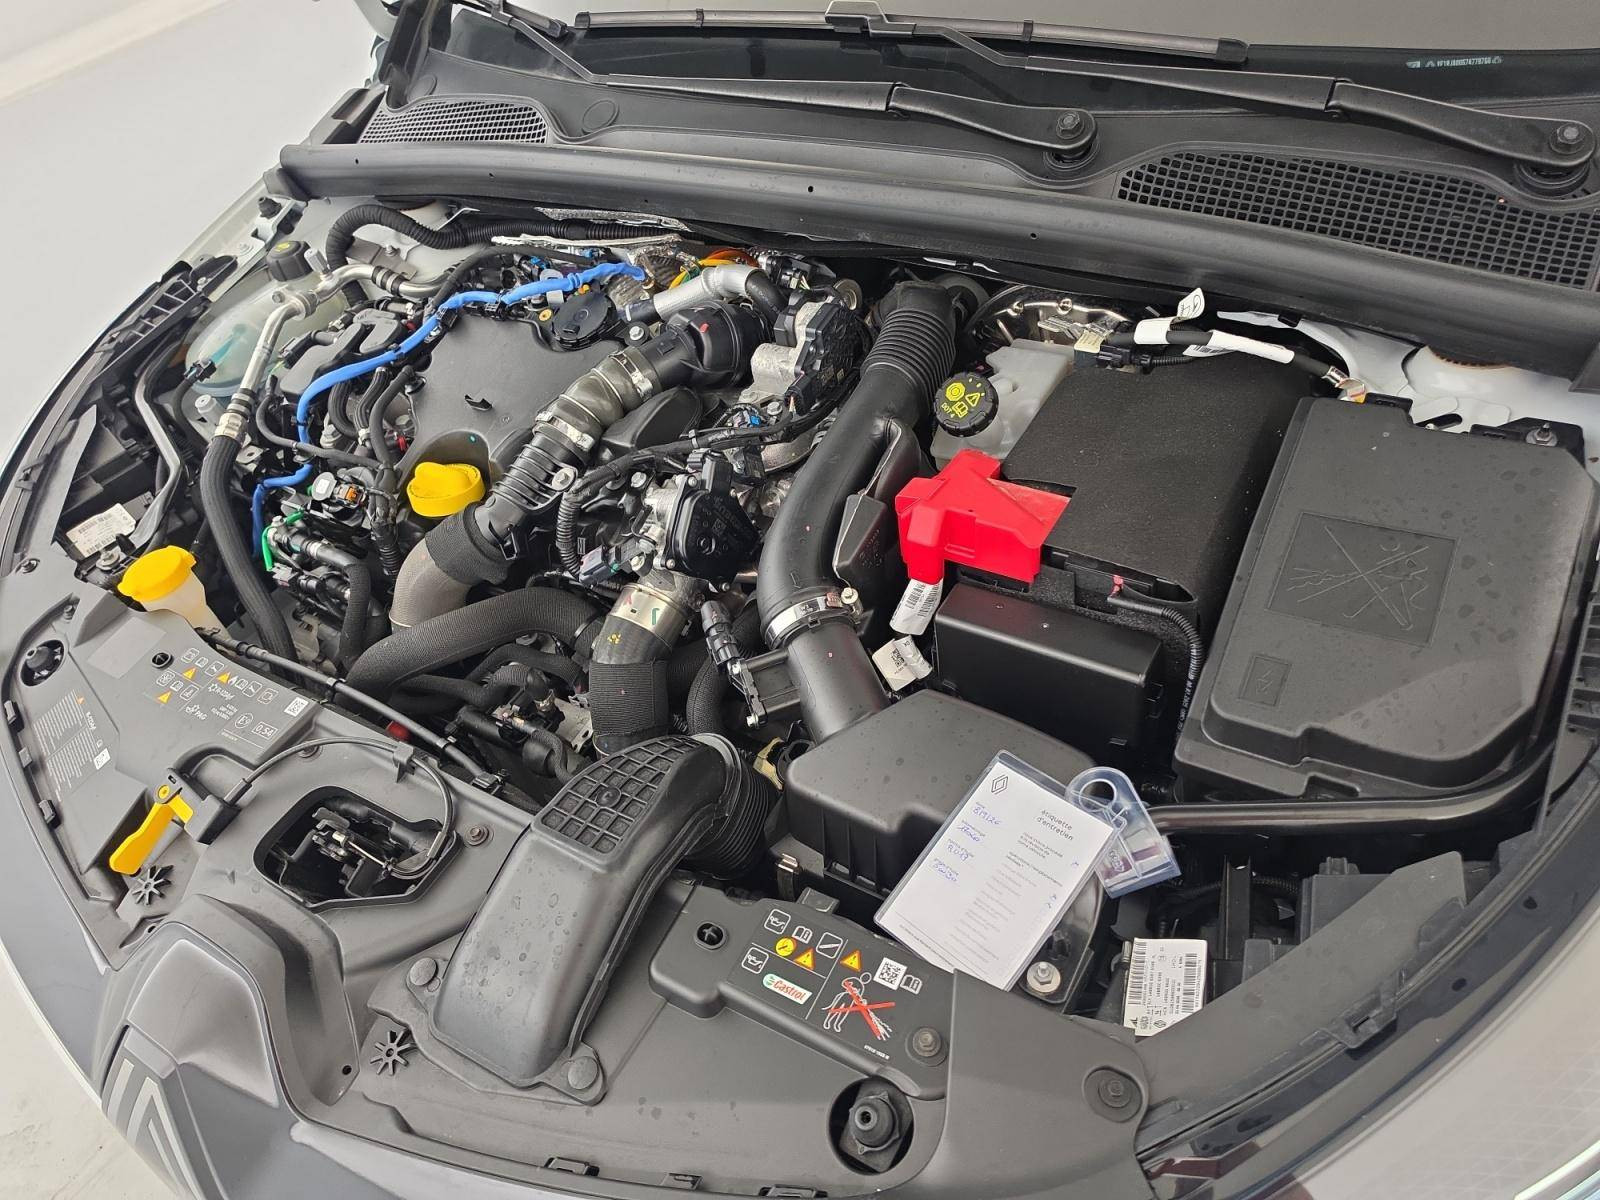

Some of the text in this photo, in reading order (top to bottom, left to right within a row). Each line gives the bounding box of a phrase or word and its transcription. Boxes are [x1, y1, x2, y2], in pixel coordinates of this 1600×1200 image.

[941, 402, 952, 414] DOT
[194, 710, 208, 721] PAG
[772, 979, 807, 1001] Castrol
